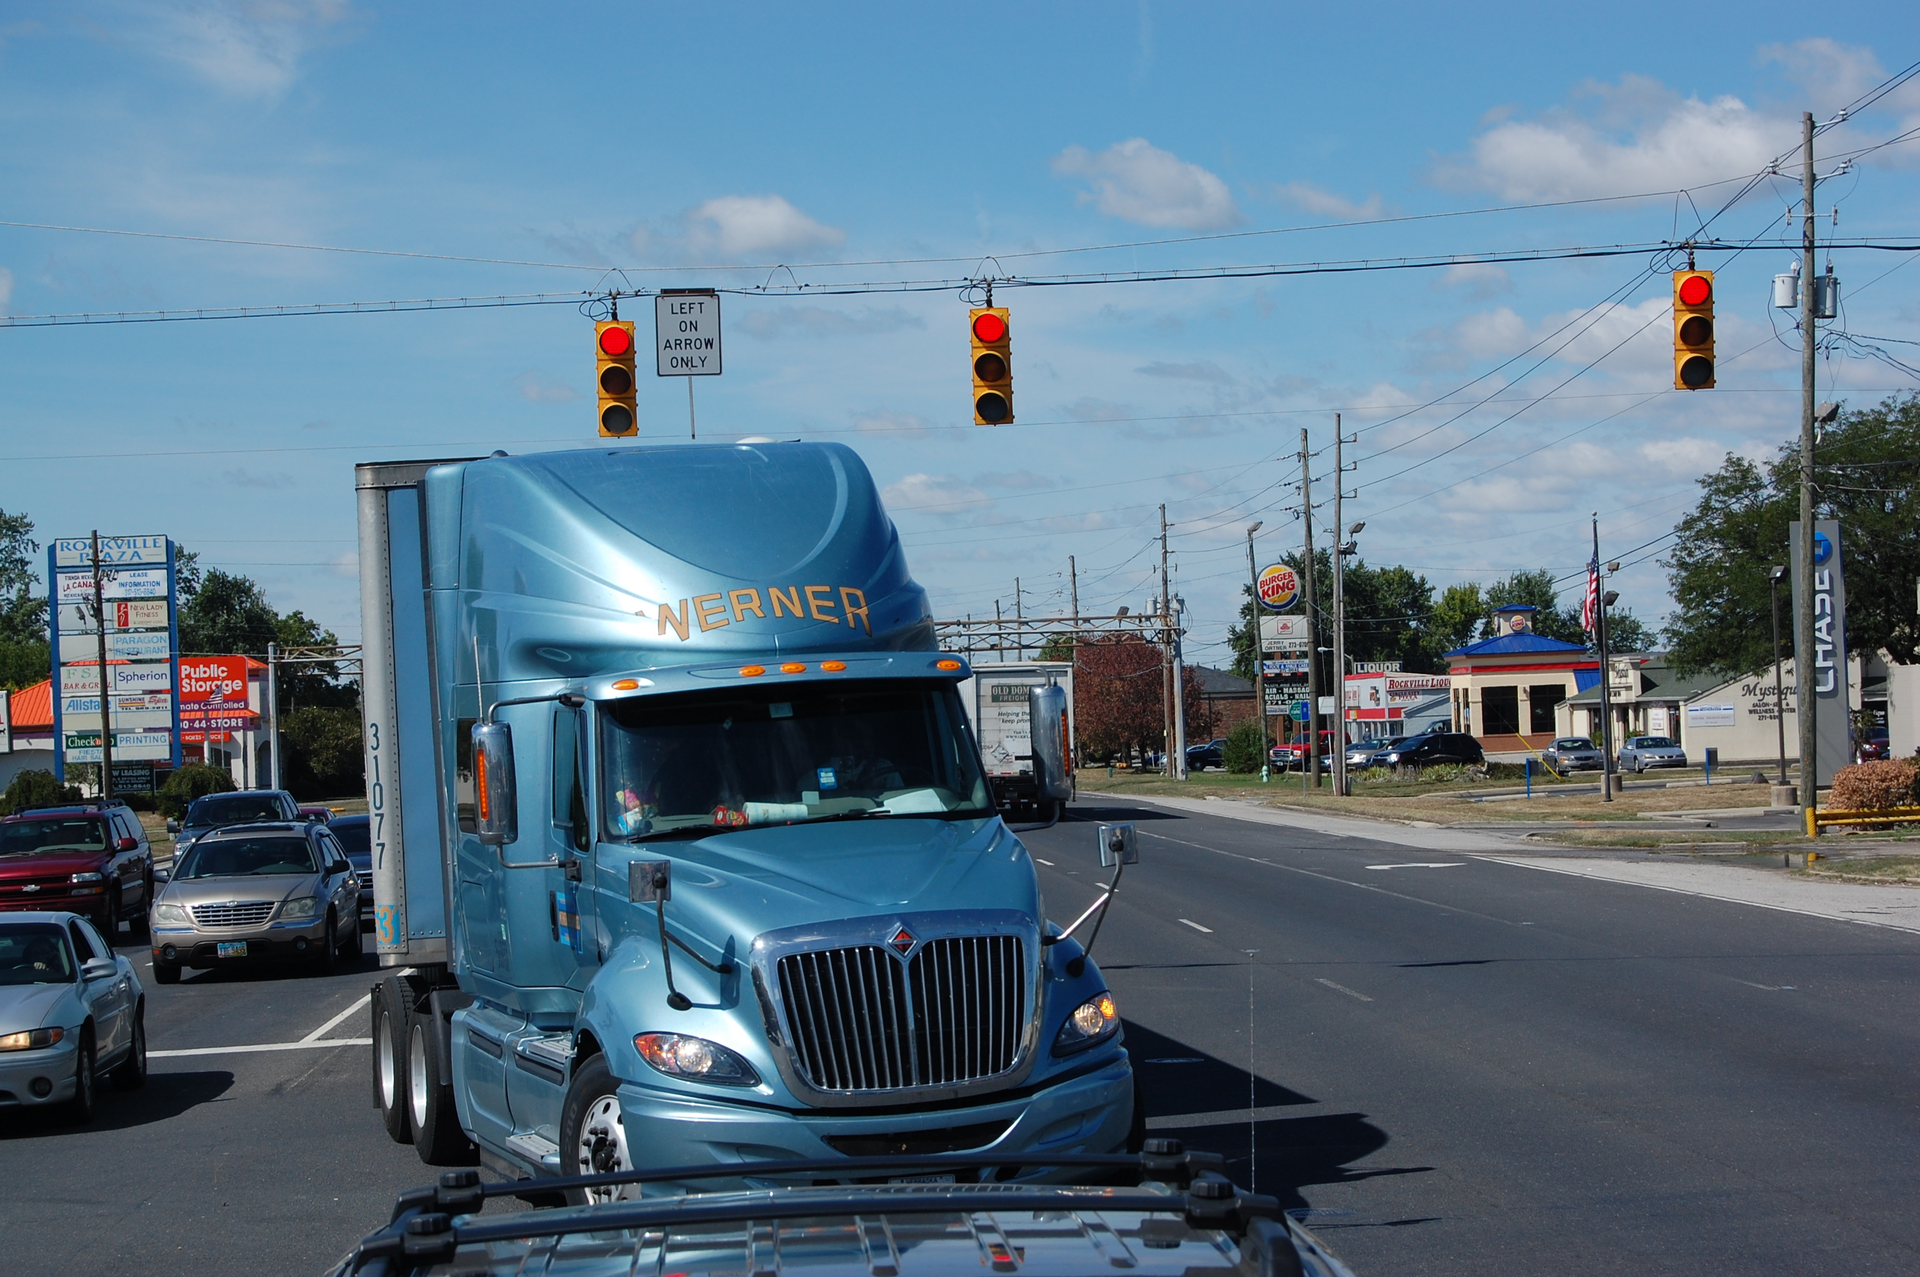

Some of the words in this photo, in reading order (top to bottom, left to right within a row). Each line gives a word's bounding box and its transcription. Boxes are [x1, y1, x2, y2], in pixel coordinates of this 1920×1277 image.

[671, 302, 705, 315] LEFT
[678, 320, 698, 332] ON
[663, 338, 714, 350] ARROW
[670, 356, 708, 368] ONLY
[60, 538, 162, 552] ROKVILLE
[80, 550, 144, 563] PAZA
[1259, 571, 1294, 588] BURGER
[62, 584, 71, 592] LA
[72, 580, 105, 590] CANASA
[1261, 579, 1296, 600] KING
[1815, 568, 1834, 693] CHASE
[116, 636, 167, 645] PARAGON
[116, 646, 168, 656] RESTAURANT
[181, 664, 228, 678] Public
[1357, 663, 1400, 673] LIQUOR
[118, 671, 168, 684] Spherion
[182, 679, 243, 694] Storage
[1388, 678, 1430, 690] ROCKVILLE
[992, 686, 1009, 695] OLD
[1011, 686, 1030, 695] DOM
[1742, 682, 1798, 702] Mystqu
[66, 699, 112, 711] Allstae
[120, 735, 167, 744] PRINTING
[370, 722, 386, 870] 31077
